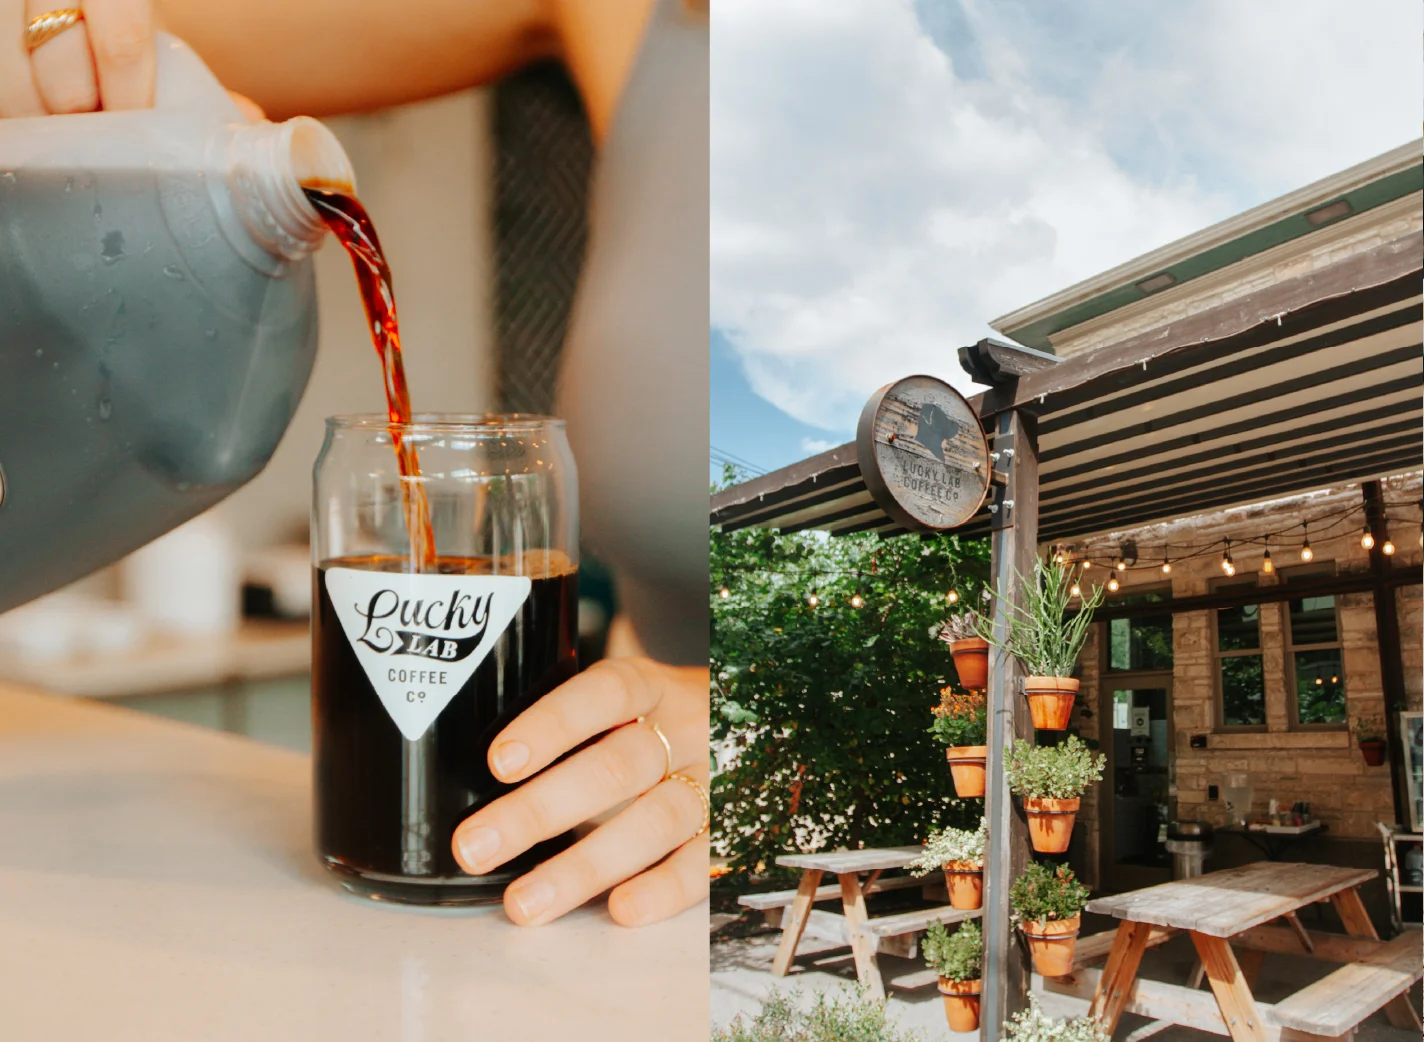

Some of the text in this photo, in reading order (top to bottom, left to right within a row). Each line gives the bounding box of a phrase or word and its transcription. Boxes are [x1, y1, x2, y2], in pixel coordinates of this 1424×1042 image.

[903, 460, 961, 489] LUCKY LAB
[903, 476, 942, 499] COFFEE
[354, 588, 495, 654] Lucky
[406, 634, 458, 659] LAB
[388, 668, 448, 685] COFFEE
